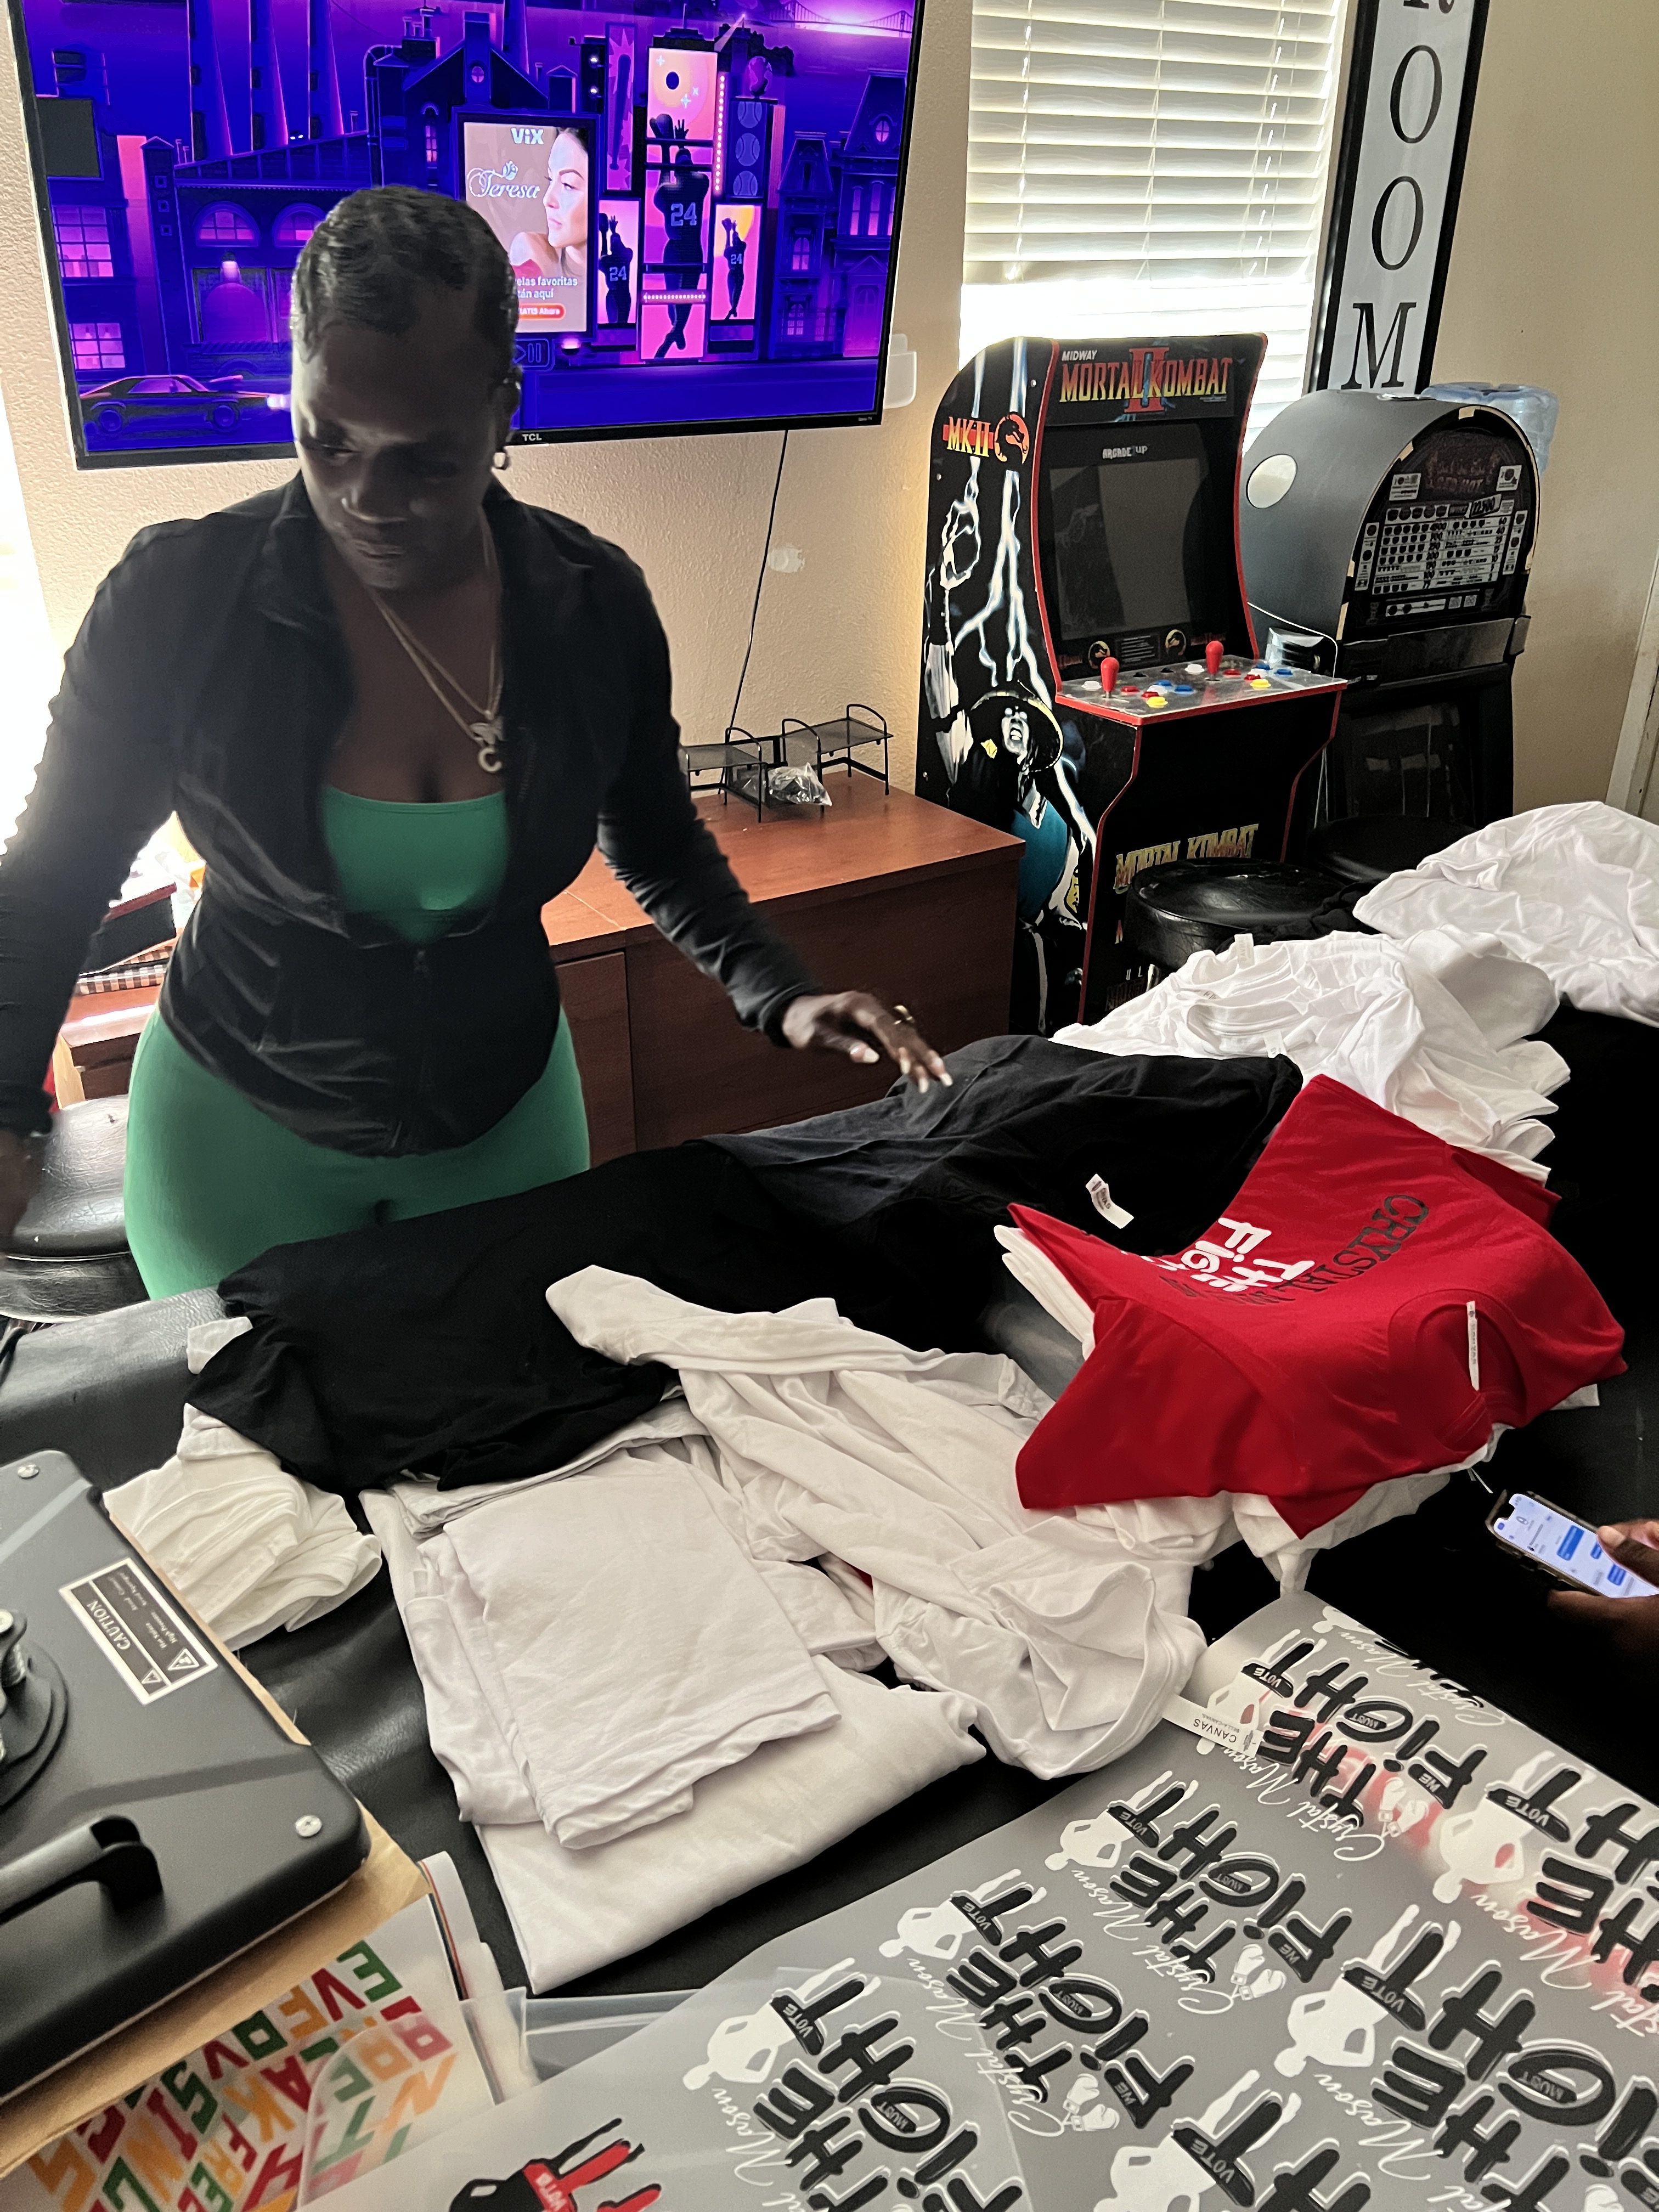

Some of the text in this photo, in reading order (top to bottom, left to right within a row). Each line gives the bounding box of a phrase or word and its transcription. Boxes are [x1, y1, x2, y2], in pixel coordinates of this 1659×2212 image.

[511, 128, 544, 145] ViX
[467, 166, 540, 198] Teresa
[1341, 0, 1454, 389] OOM
[671, 202, 697, 226] 24
[610, 266, 627, 281] 24
[730, 253, 742, 264] 24
[516, 276, 578, 286] elas favoritas
[517, 288, 554, 300] tán aquí
[1062, 350, 1097, 361] MIDWAY
[1059, 360, 1144, 403] MORTAL
[1148, 357, 1233, 398] KOMBAT
[1272, 1193, 1430, 1293] CRYSTAL
[1190, 1259, 1315, 1293] THE
[87, 1601, 131, 1650] CAUTION
[1341, 1632, 1419, 1678] Mason
[1254, 1667, 1282, 1688] VOTE
[1193, 1718, 1237, 1743] CANVAS
[1348, 1713, 1379, 1729] MUST
[1257, 1710, 1376, 1827] THE
[1418, 1773, 1442, 1792] WE
[1221, 1747, 1385, 1861] Crystal Mason
[1506, 1795, 1548, 1827] VOTE
[1119, 1811, 1147, 1836] VOTE
[1216, 1874, 1244, 1891] MUST
[963, 1901, 992, 1931] VOTE
[1110, 1856, 1236, 1984] THE
[1527, 1857, 1659, 2004] HE
[1071, 1870, 1234, 2015] Crystal Mason
[1278, 1944, 1301, 1964] WE
[1470, 1894, 1601, 1990] Mason
[1056, 1989, 1084, 2015] MUST
[1362, 1976, 1405, 2012] VOTE
[783, 2004, 814, 2039] VOTE
[946, 1951, 1073, 2103] THE
[907, 1957, 1064, 2137] Crystal Mason
[223, 1995, 453, 2142] BREAK
[1114, 2081, 1137, 2106] WE
[1519, 2071, 1564, 2101] MUST
[878, 2102, 909, 2129] MUST
[1314, 2074, 1444, 2180] Mason
[1372, 2046, 1570, 2212] THE
[712, 2087, 792, 2186] Mason
[753, 2067, 888, 2212] THE
[1191, 2140, 1234, 2183] VOTE
